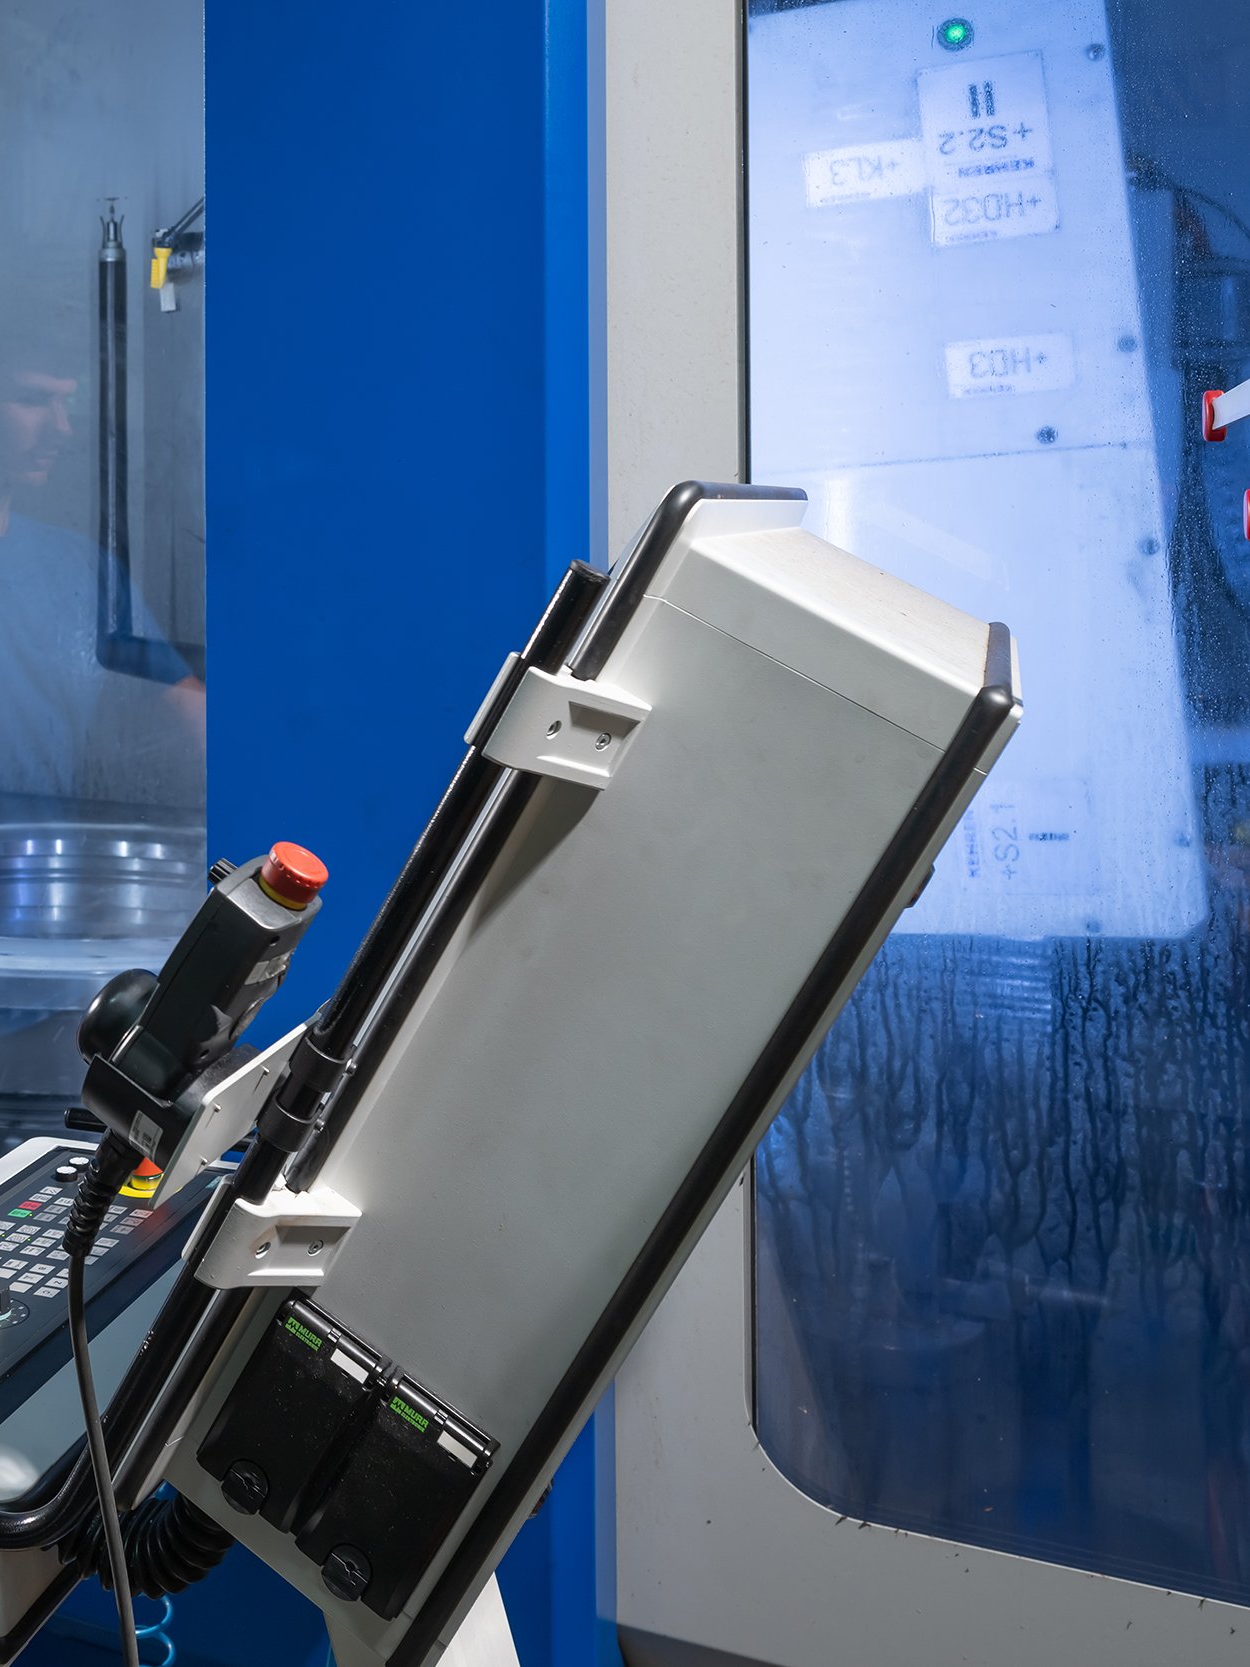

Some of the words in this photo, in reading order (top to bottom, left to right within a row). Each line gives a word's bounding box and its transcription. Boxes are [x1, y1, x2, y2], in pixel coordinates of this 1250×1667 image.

[938, 122, 1034, 156] +S2.2
[299, 1324, 323, 1348] MURR
[404, 1405, 430, 1429] MURR
